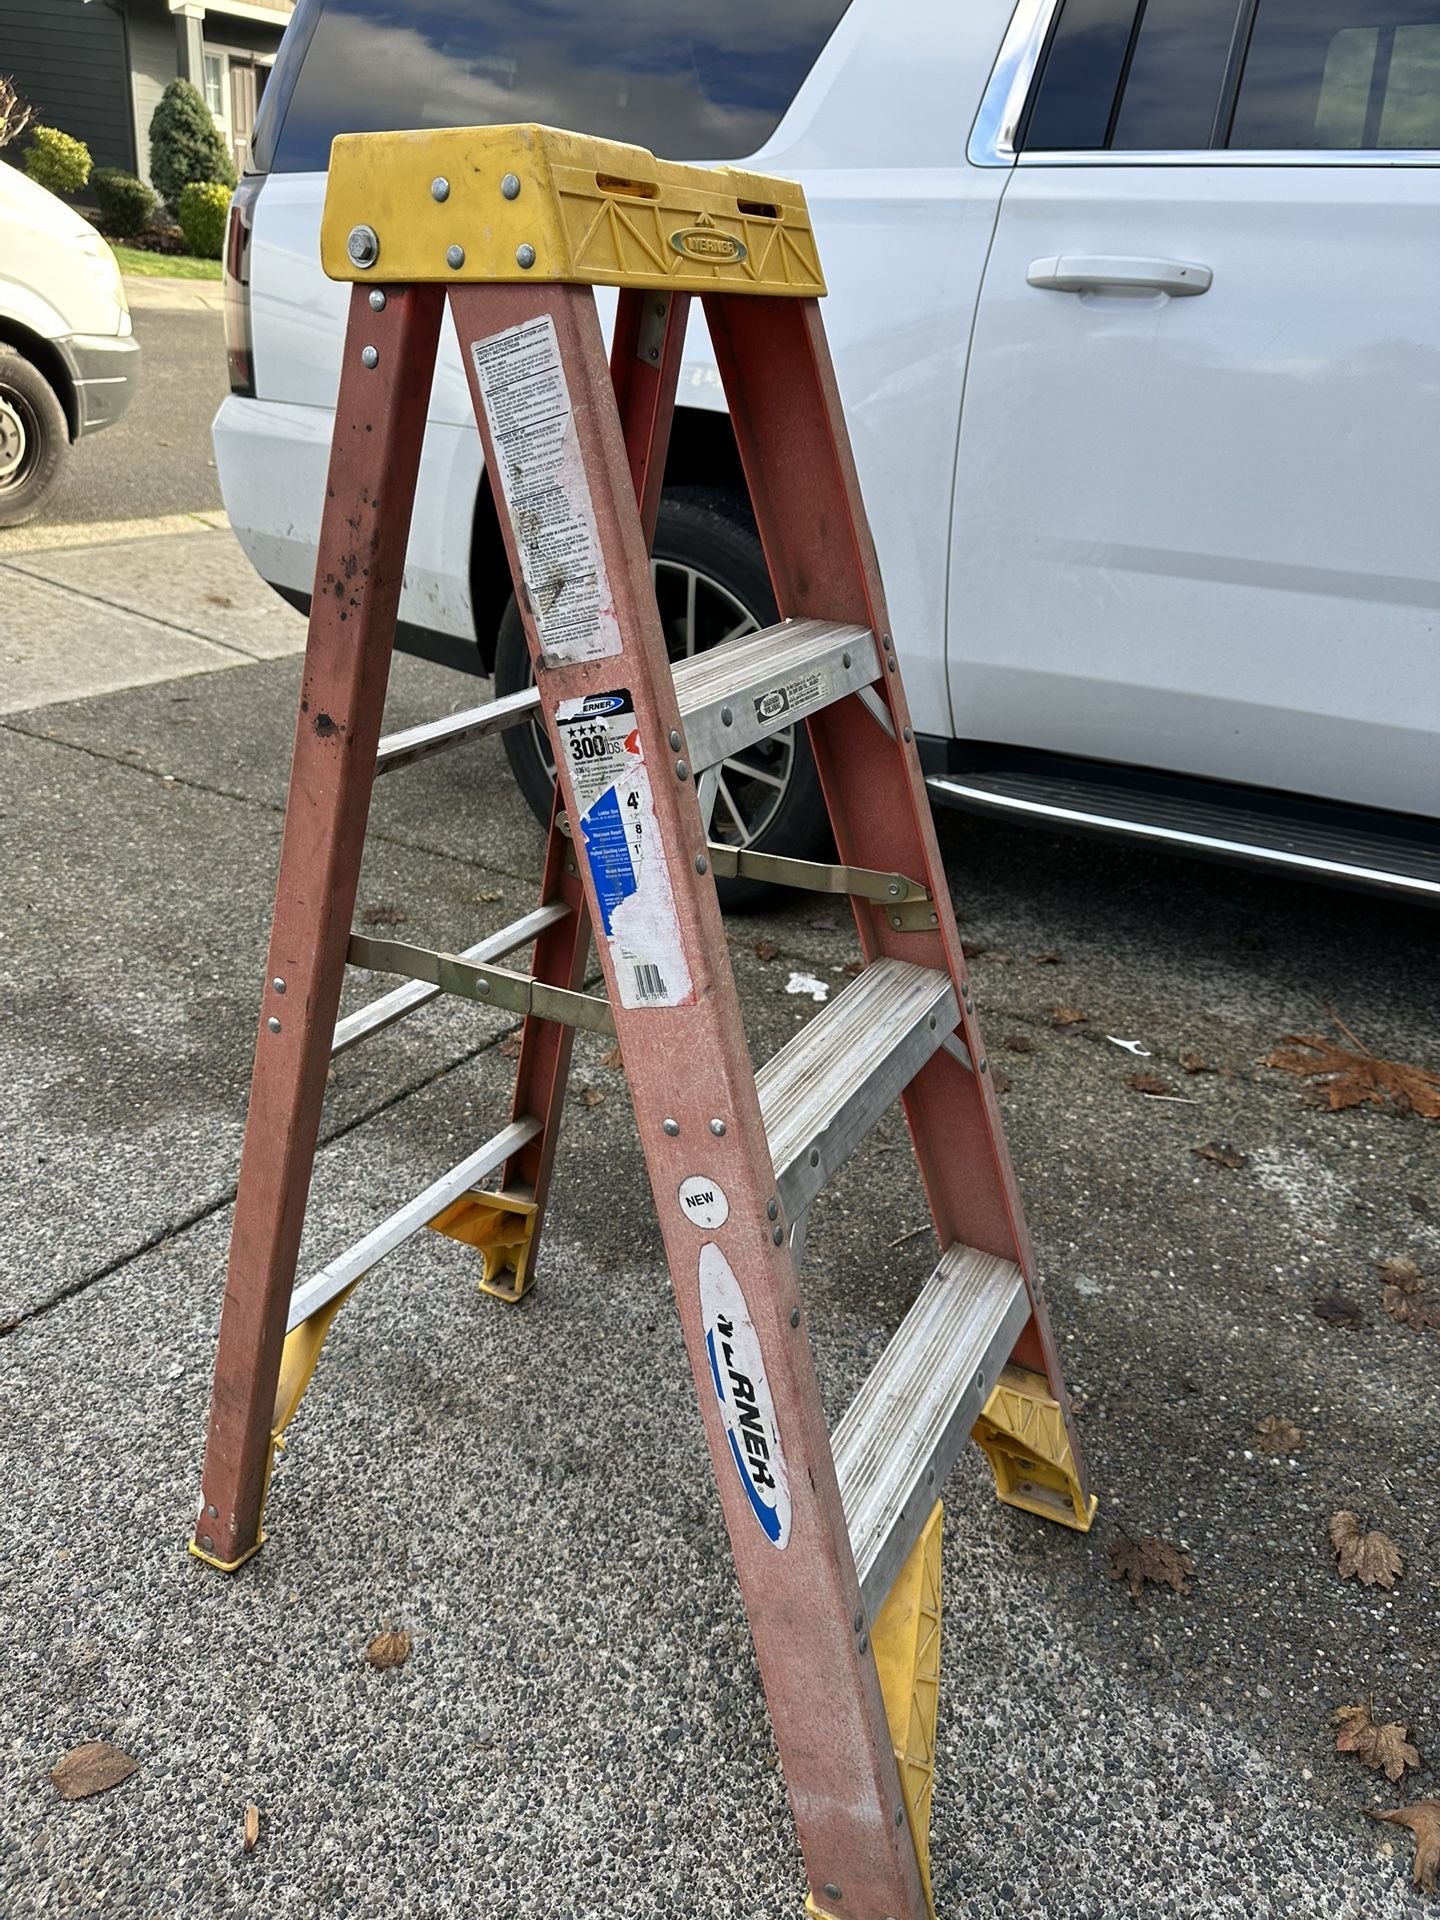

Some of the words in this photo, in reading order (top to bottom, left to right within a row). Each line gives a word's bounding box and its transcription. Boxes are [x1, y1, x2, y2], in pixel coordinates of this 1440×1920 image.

[477, 352, 492, 360] SAFETY
[492, 342, 519, 355] INSTRUCTIONS
[486, 387, 508, 398] INSPECTION
[496, 434, 511, 442] PROPER
[512, 500, 527, 508] PROPER
[583, 700, 612, 712] ERNER
[570, 735, 605, 760] 300
[627, 791, 640, 810] 4'
[685, 1191, 714, 1208] NEW
